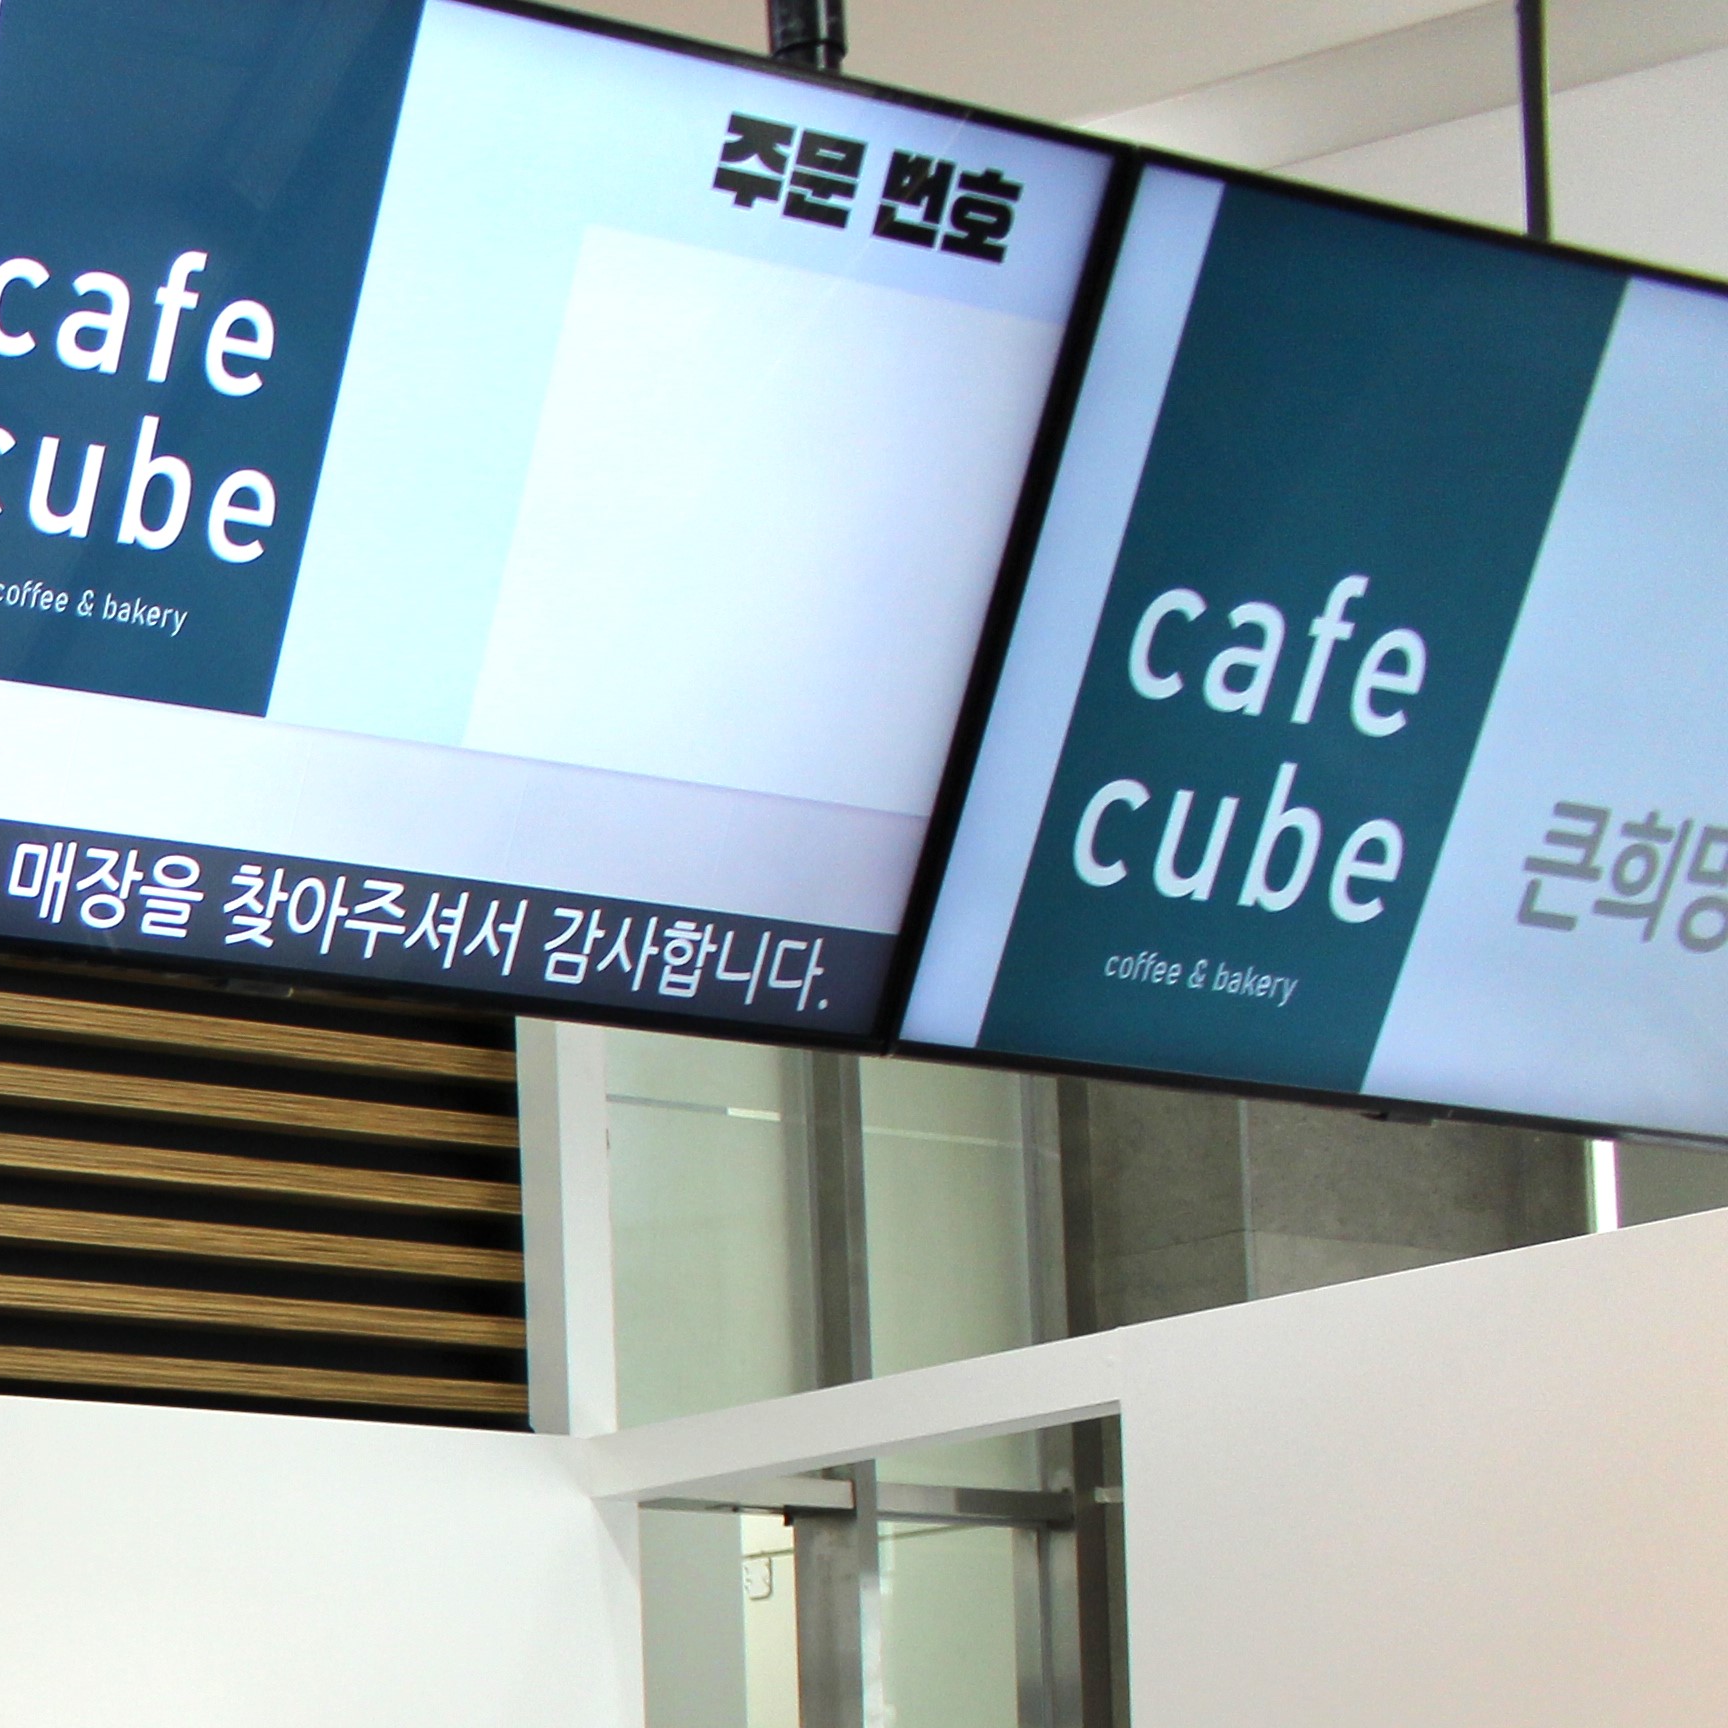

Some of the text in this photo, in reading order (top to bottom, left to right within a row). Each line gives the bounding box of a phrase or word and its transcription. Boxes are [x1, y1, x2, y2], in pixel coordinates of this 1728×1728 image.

[712, 114, 1022, 263] 주문 번호
[76, 588, 96, 617] &
[101, 592, 189, 637] bakery
[1128, 573, 1427, 739] cafe
[1072, 760, 1404, 924] cube
[7, 840, 205, 938] 매장을
[222, 863, 529, 975] 찾아주셔서
[542, 906, 830, 1011] 감사합니다.
[1103, 950, 1300, 1008] coffee & bakery
